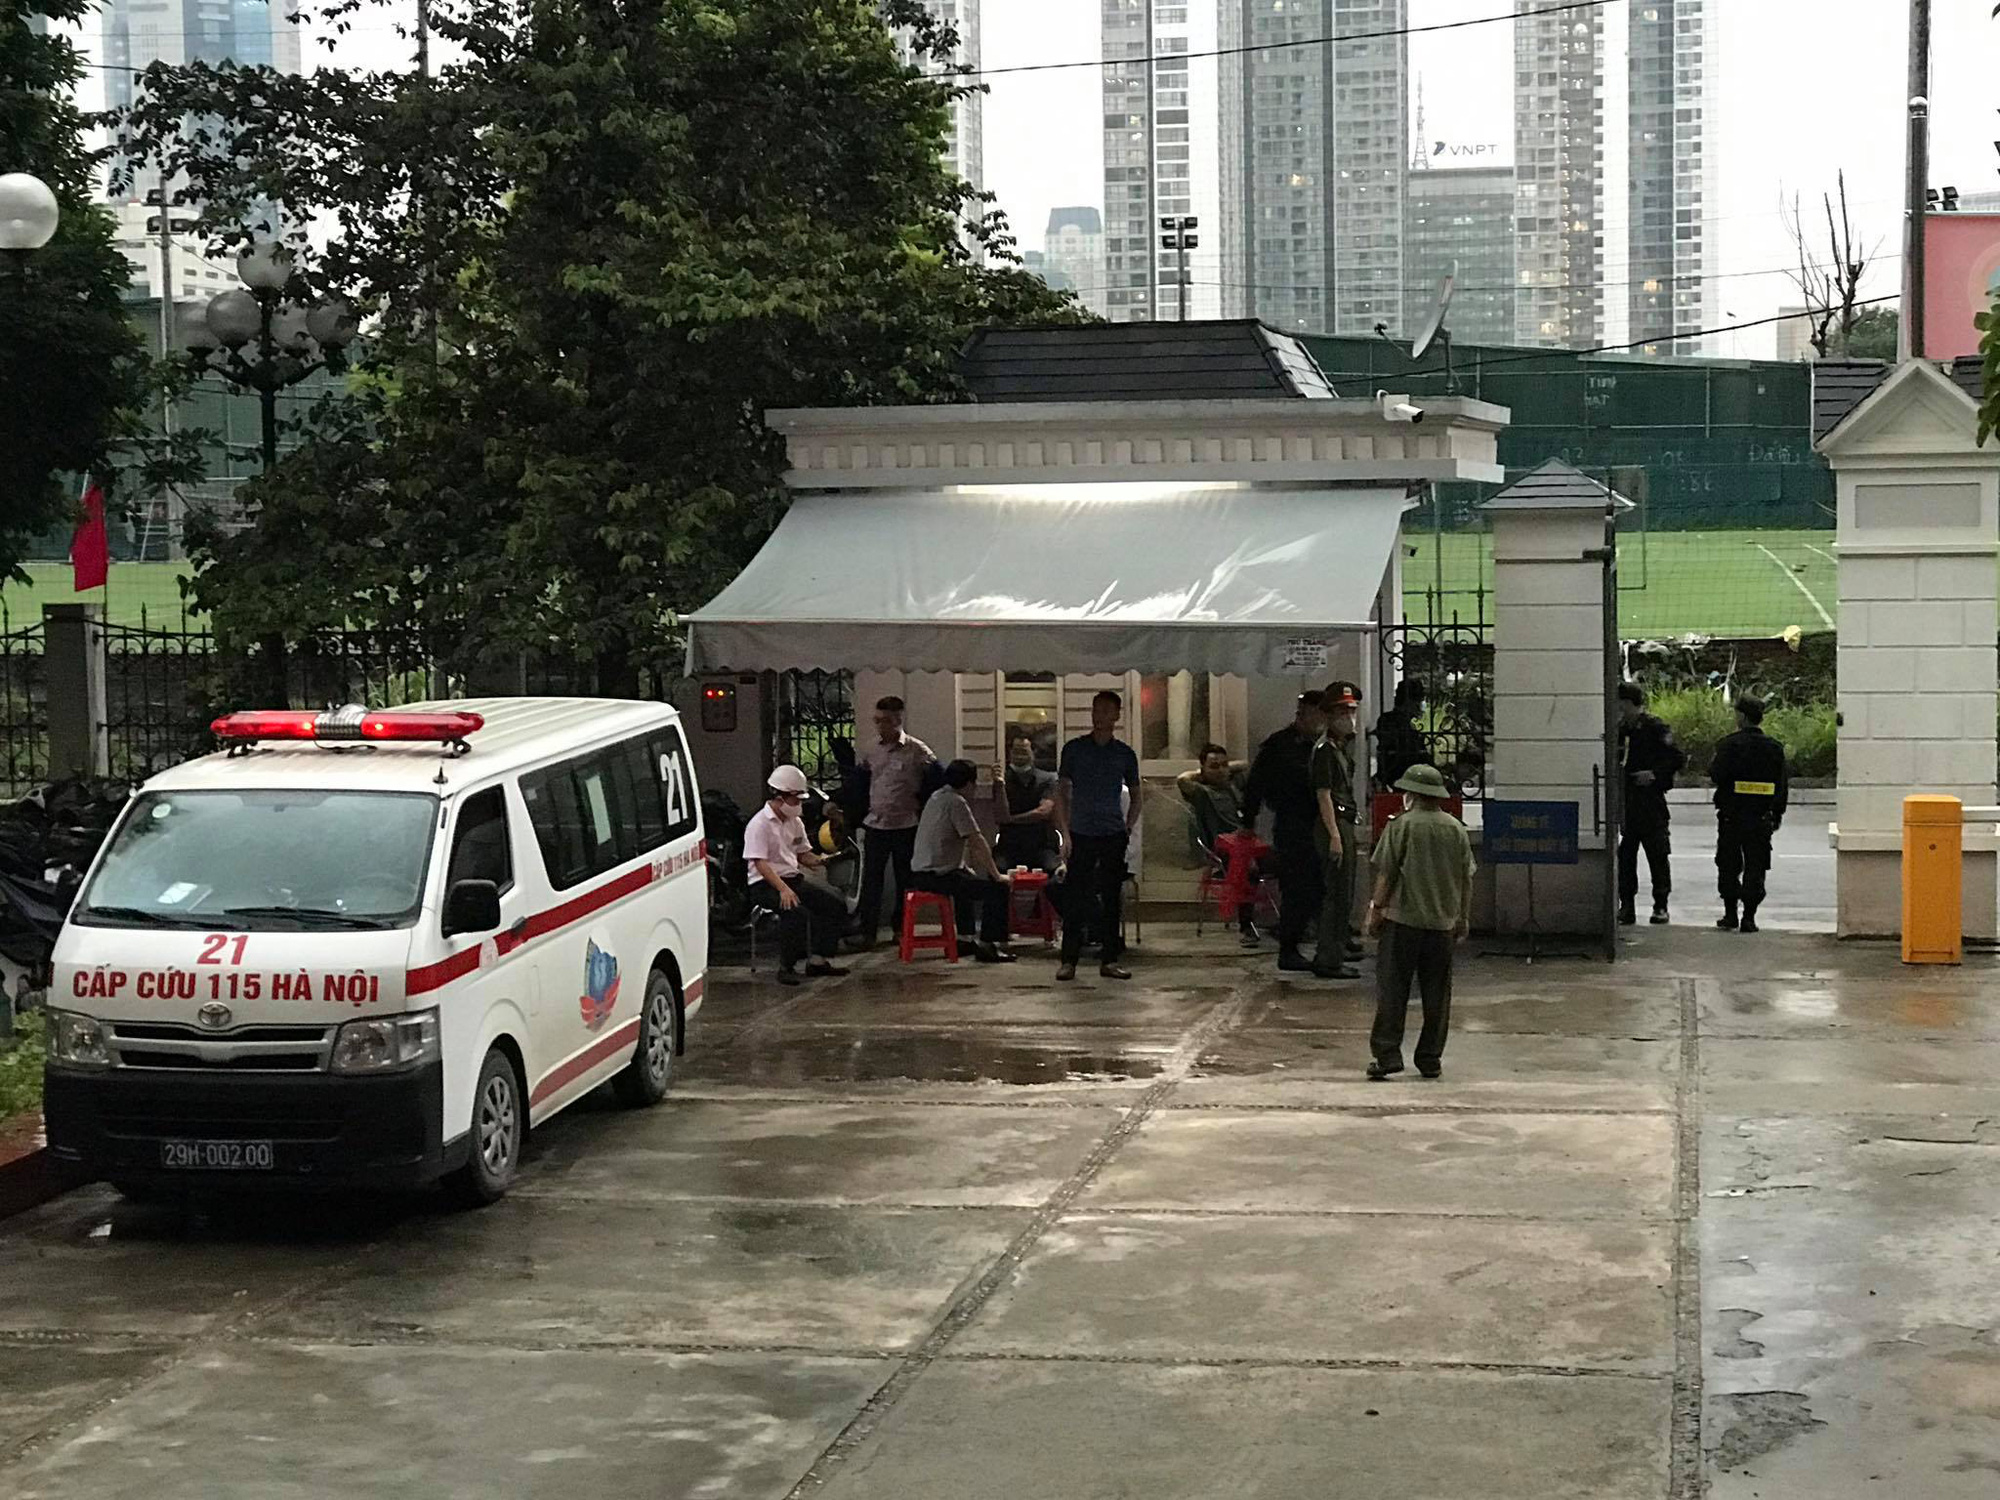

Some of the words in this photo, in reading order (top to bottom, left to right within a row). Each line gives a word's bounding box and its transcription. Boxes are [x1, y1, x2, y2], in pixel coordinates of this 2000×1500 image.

[1450, 144, 1498, 155] VNPT
[660, 750, 688, 826] 21
[196, 934, 249, 965] 21
[72, 963, 127, 998] CẤP
[136, 965, 196, 1000] CỨU
[207, 973, 261, 1000] 115
[271, 968, 312, 1001] HÀ
[323, 969, 379, 1006] NỘI
